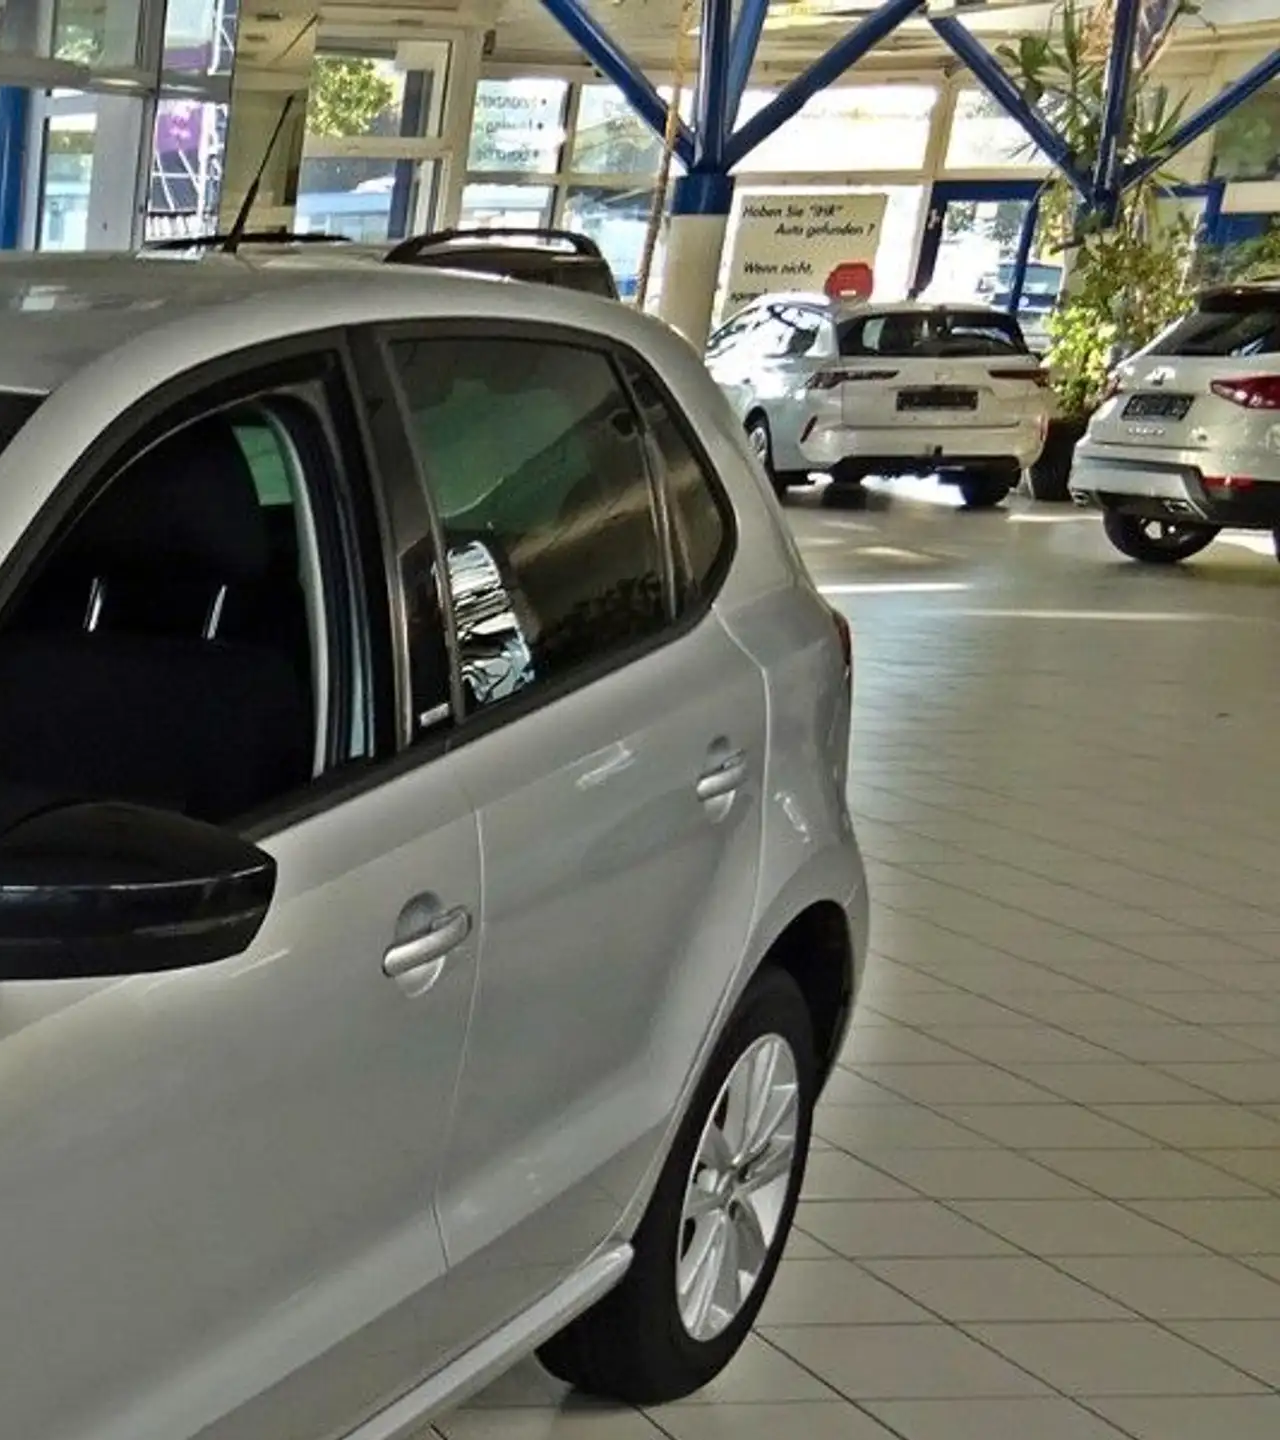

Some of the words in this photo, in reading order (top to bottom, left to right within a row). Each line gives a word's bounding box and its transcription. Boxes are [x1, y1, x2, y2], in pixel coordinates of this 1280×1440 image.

[742, 205, 782, 218] Haben
[788, 204, 804, 217] Sie
[775, 223, 803, 235] Auto
[806, 221, 864, 238] gefunden
[744, 261, 778, 274] Wenn
